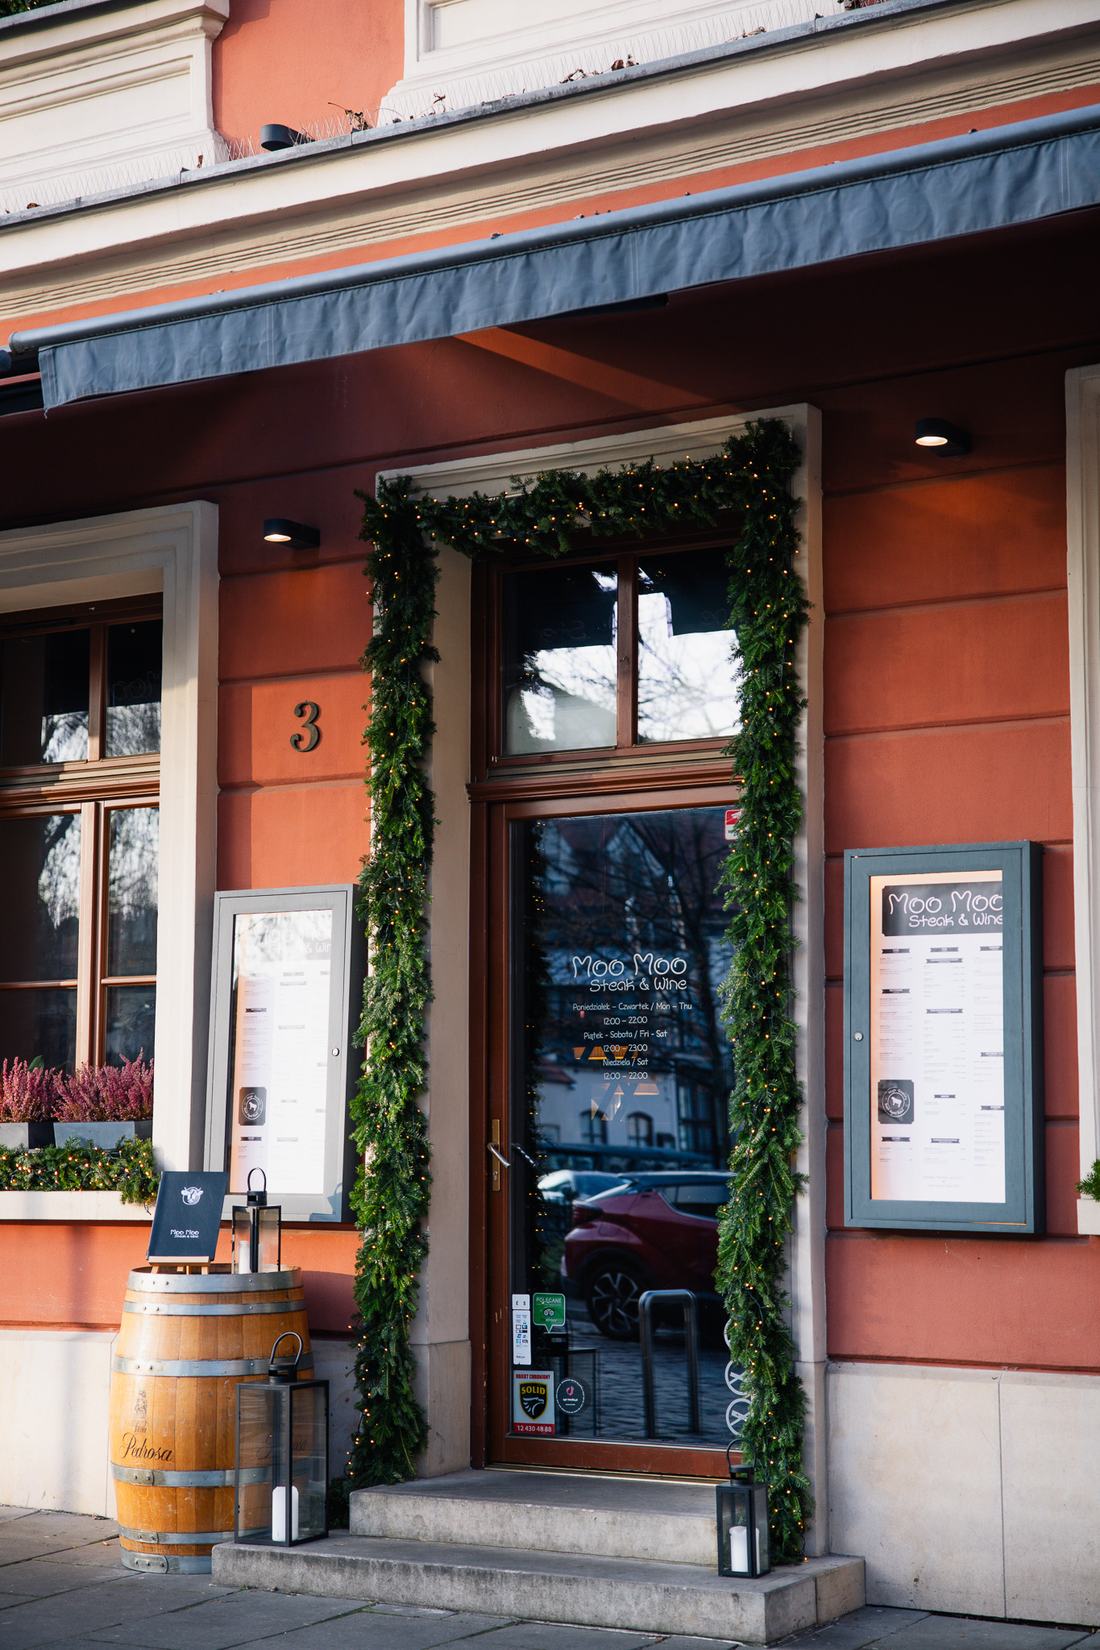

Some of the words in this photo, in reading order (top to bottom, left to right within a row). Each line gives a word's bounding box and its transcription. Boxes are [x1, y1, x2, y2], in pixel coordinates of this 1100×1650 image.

[290, 701, 321, 752] 3
[888, 893, 942, 915] Moo
[951, 890, 1003, 913] Moo
[909, 914, 954, 928] Steak
[958, 913, 969, 926] &
[972, 912, 1003, 926] Wine
[572, 955, 625, 978] Moo
[633, 952, 687, 975] Moo
[589, 978, 635, 992] Steak
[639, 977, 650, 990] &
[653, 977, 687, 990] Wine
[656, 1002, 670, 1010] Mon
[679, 1001, 693, 1010] Thu
[610, 1030, 633, 1039] Sobota
[639, 1029, 649, 1038] Fri
[655, 1029, 668, 1038] Sat
[637, 1057, 649, 1066] Sat
[521, 1386, 546, 1395] SOLID
[122, 1431, 173, 1462] Pedrosa
